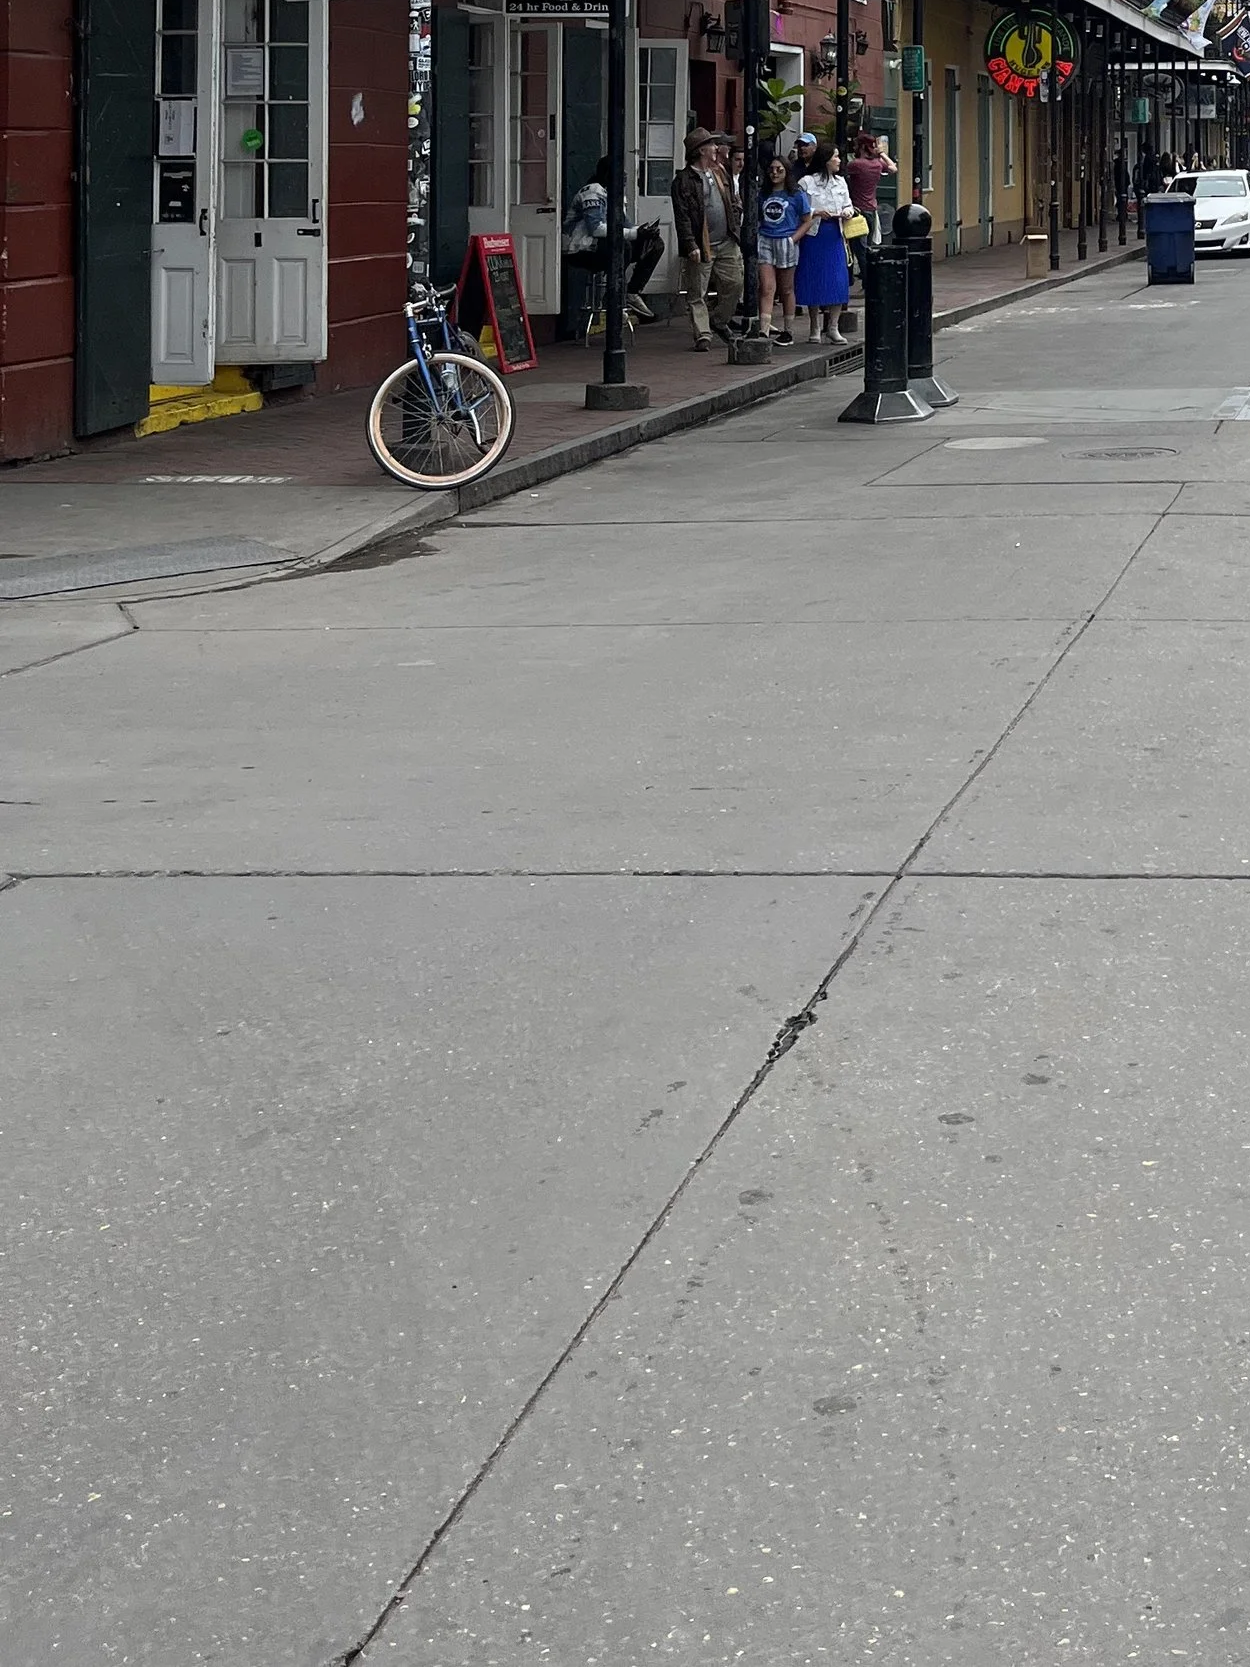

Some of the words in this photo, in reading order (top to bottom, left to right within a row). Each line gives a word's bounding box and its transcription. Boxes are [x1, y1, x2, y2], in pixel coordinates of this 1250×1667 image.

[509, 2, 523, 12] 24
[527, 2, 539, 12] hr
[542, 1, 568, 12] Food
[571, 2, 581, 12] &
[583, 1, 609, 12] Drin
[988, 57, 1073, 97] CANTA
